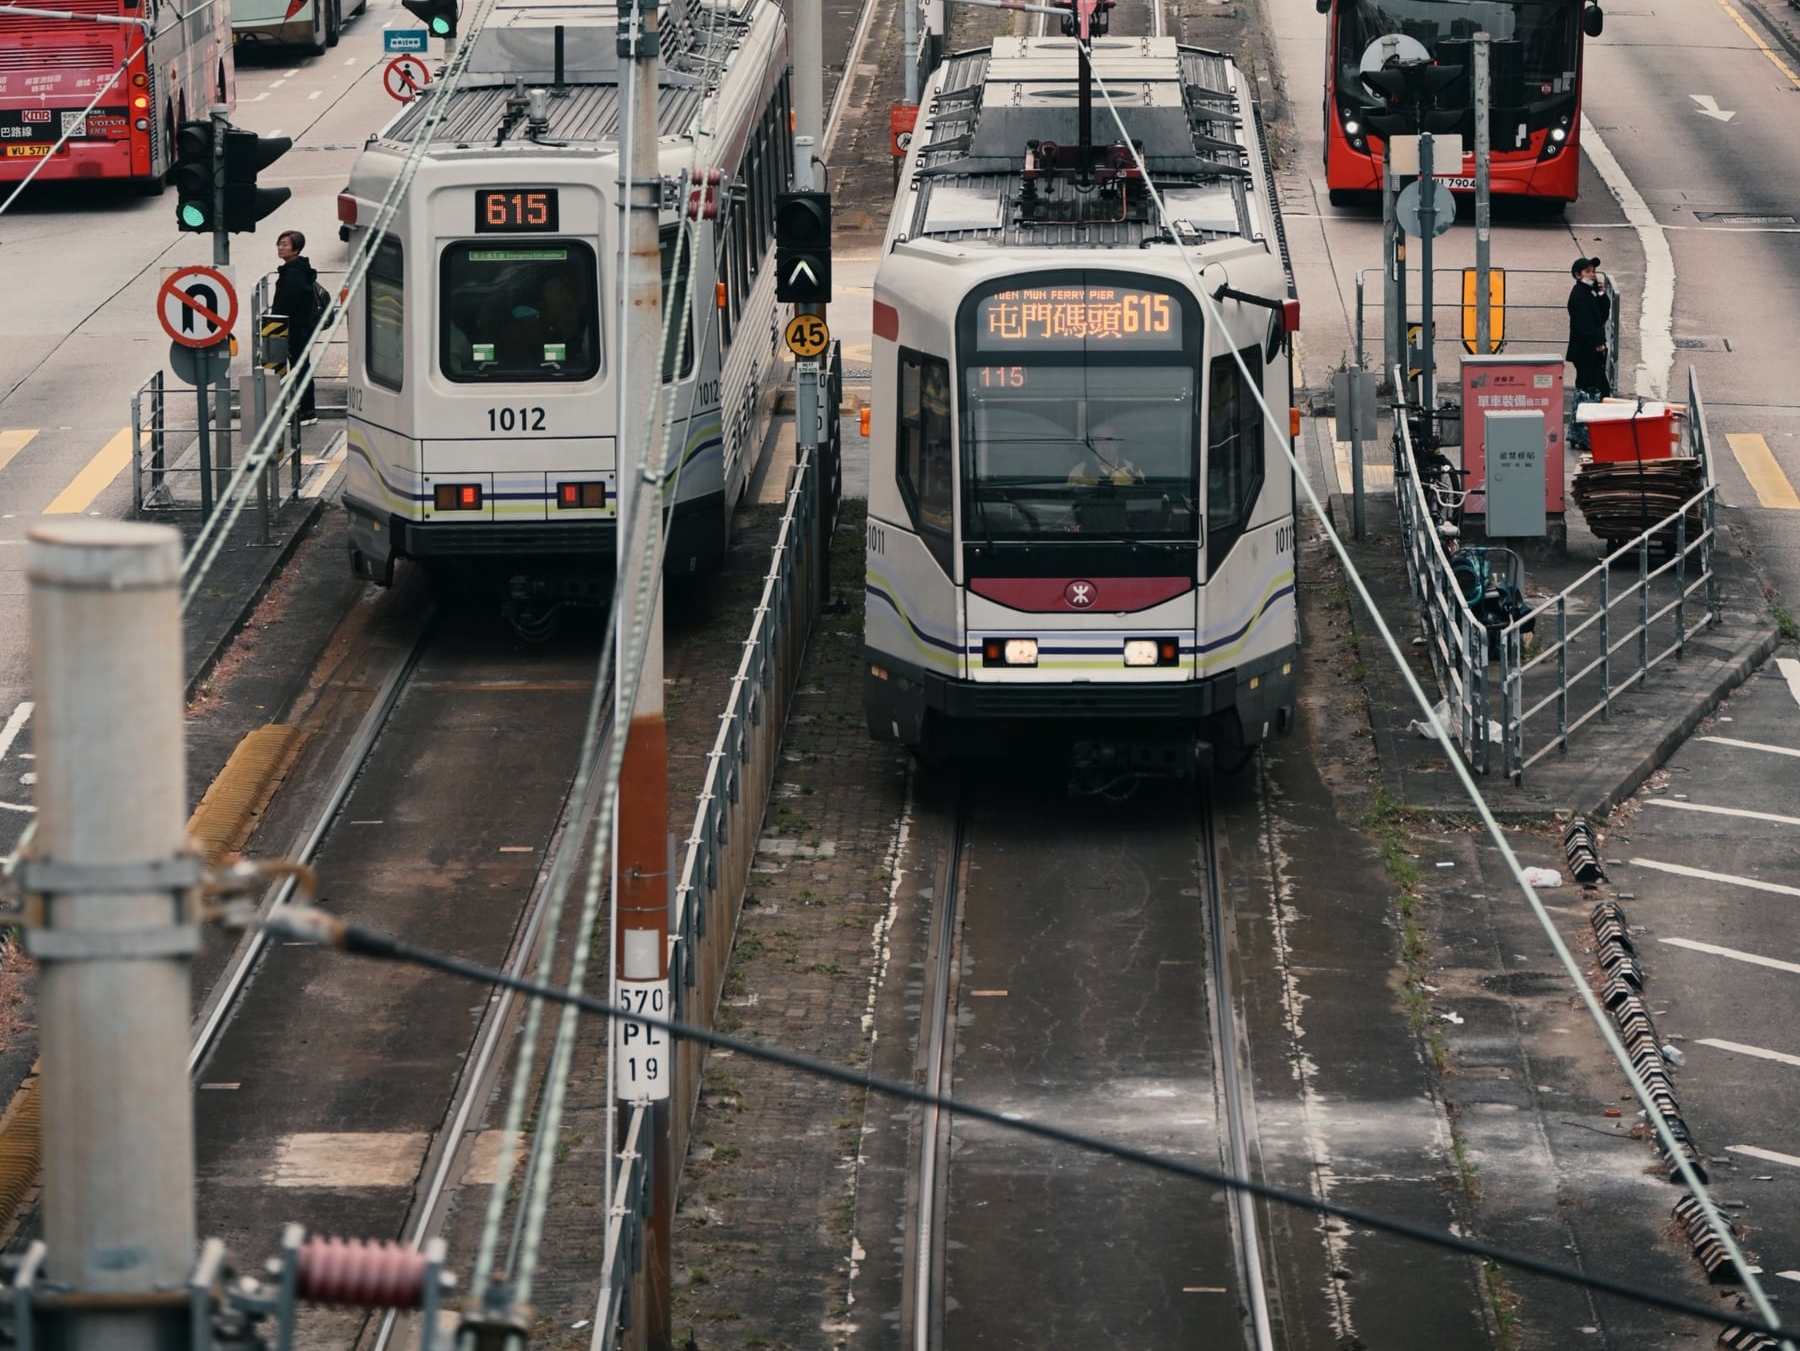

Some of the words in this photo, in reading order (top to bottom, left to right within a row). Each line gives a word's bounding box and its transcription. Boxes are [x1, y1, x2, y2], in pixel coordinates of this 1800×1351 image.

[23, 111, 50, 122] KMB
[90, 119, 126, 127] VOLVO
[1, 126, 32, 138] 巴路線
[1448, 178, 1476, 188] 7904
[486, 194, 548, 225] 615
[1024, 290, 1047, 300] MUN
[1051, 290, 1085, 300] FERRY
[1089, 290, 1115, 300] PIER
[988, 302, 1123, 339] 屯門碼頭
[1122, 294, 1170, 333] 615
[791, 322, 825, 348] 45
[698, 381, 720, 406] 1012
[487, 407, 547, 431] 1012
[868, 525, 885, 555] 1011
[1275, 524, 1293, 555] 1011
[620, 988, 663, 1013] 570
[623, 1021, 661, 1046] PL
[628, 1057, 658, 1082] 19
